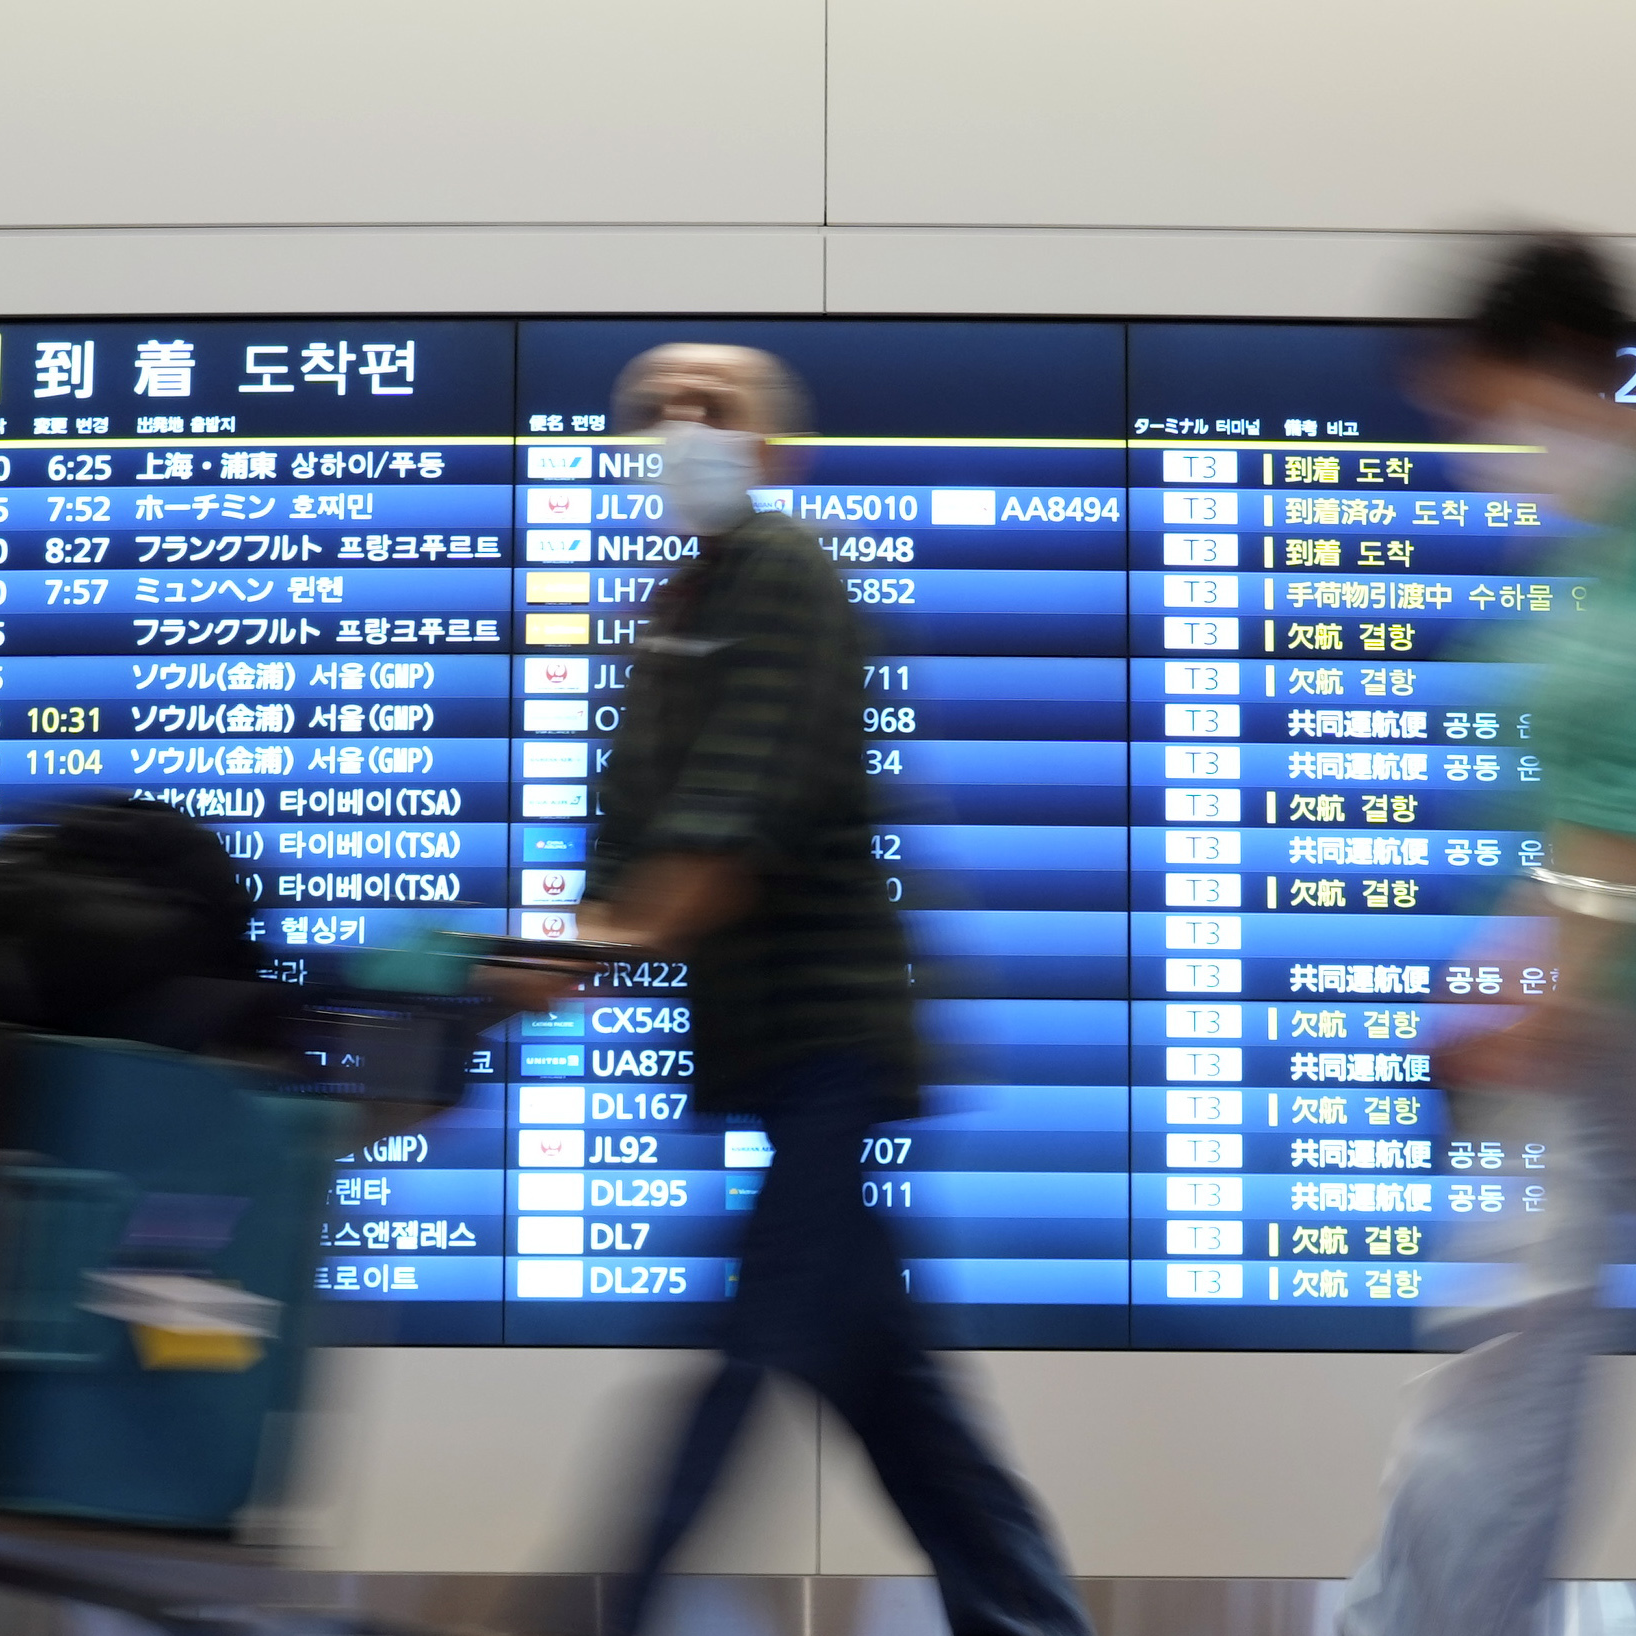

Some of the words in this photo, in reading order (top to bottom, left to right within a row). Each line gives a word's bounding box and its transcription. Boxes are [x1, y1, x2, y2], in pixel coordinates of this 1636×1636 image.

[239, 341, 414, 395] 도착편
[571, 415, 605, 431] 편명
[1135, 418, 1208, 434] ターミナル
[1216, 419, 1259, 435] 터미널
[1327, 421, 1359, 436] 비고
[48, 455, 111, 480] 6:25
[291, 452, 445, 478] 상하이/푸동
[600, 453, 663, 477] NH9
[1183, 456, 1216, 478] T3
[1285, 457, 1340, 483] 到着
[1357, 458, 1413, 484] 도착
[48, 496, 110, 522] 7:52
[136, 494, 275, 520] ホーチミン
[290, 493, 372, 519] 호찌민
[596, 495, 663, 519] JL70
[801, 495, 917, 520] HA5010
[1001, 497, 1119, 522] AA8494
[1183, 498, 1216, 520] T3
[1286, 498, 1396, 525] 到着済み
[1413, 500, 1468, 526] 도착
[1485, 501, 1540, 527] 완료
[46, 538, 110, 563] 8:27
[136, 535, 322, 562] フランクフルト
[338, 535, 501, 561] 프랑크푸르트
[598, 536, 699, 561] NH204
[819, 537, 913, 562] H4948
[1183, 539, 1216, 561] T3
[1286, 539, 1341, 566] 到着
[1358, 540, 1414, 567] 도착
[45, 579, 108, 605] 7:57
[136, 578, 273, 603] ミュンヘン
[288, 576, 343, 603] 뮌헨
[598, 578, 667, 602] LH7
[848, 579, 915, 603] 5852
[1184, 581, 1217, 603] T3
[1287, 581, 1452, 609] 手荷物引渡中
[1469, 584, 1553, 611] 수하물
[134, 618, 320, 645] フランクフルト
[336, 618, 500, 644] 프랑크푸르트
[1183, 623, 1217, 645] T3
[1288, 623, 1342, 650] 欠航
[1360, 623, 1415, 651] 결항
[133, 662, 295, 691] ソウル(金浦)
[864, 666, 908, 690] 711
[1184, 668, 1218, 690] T3
[1289, 668, 1343, 695] 欠航
[1361, 668, 1416, 696] 결항
[28, 707, 98, 732] 10:31
[132, 704, 294, 733] ソウル(金浦)
[864, 708, 915, 733] 968
[1185, 710, 1218, 732] T3
[1288, 710, 1427, 738] 共同運航便
[1443, 713, 1499, 739] 공동
[27, 749, 102, 774] 11:04
[131, 746, 294, 775] ソウル(金浦)
[867, 750, 902, 774] 34
[1185, 752, 1218, 774] T3
[1289, 752, 1428, 780] 共同運航便
[1444, 755, 1500, 781] 공동
[1517, 756, 1540, 781] 운
[280, 788, 461, 816] 타이베이(TSA)
[1185, 794, 1219, 817] T3
[1290, 794, 1345, 821] 欠航
[1362, 795, 1417, 822] 결항
[280, 831, 460, 858] 타이베이(TSA)
[1186, 837, 1219, 859] T3
[1289, 836, 1428, 865] 共同運航便
[1445, 840, 1501, 866] 공동
[1518, 841, 1544, 866] 운
[279, 873, 459, 901] 타이베이(TSA)
[1186, 879, 1219, 902] T3
[1291, 879, 1345, 906] 欠航
[1363, 879, 1418, 907] 결항
[282, 916, 364, 944] 헬싱키
[1186, 922, 1220, 945] T3
[1186, 965, 1219, 987] T3
[1290, 964, 1430, 993] 共同運航便
[1446, 967, 1503, 994] 공동
[1520, 968, 1546, 993] 운
[592, 1007, 688, 1033] CX548
[1187, 1011, 1220, 1033] T3
[1292, 1010, 1346, 1038] 欠航
[1364, 1010, 1420, 1038] 결항
[593, 1050, 693, 1076] UA875
[1187, 1054, 1220, 1076] T3
[1291, 1053, 1430, 1081] 共同運航便
[592, 1093, 687, 1119] DL167
[1188, 1097, 1220, 1119] T3
[1292, 1096, 1347, 1124] 欠航
[1365, 1096, 1420, 1124] 결항
[589, 1136, 657, 1163] JL92
[861, 1139, 911, 1163] 707
[1188, 1140, 1220, 1163] T3
[1291, 1139, 1431, 1168] 共同運航便
[1448, 1143, 1504, 1169] 공동
[1522, 1144, 1545, 1168] 운
[337, 1177, 391, 1205] 랜타
[592, 1180, 687, 1206] DL295
[865, 1182, 910, 1207] 011
[1188, 1183, 1220, 1206] T3
[1291, 1182, 1431, 1211] 共同運航便
[1448, 1185, 1505, 1212] 공동
[1522, 1186, 1544, 1211] 운
[591, 1223, 649, 1249] DL7
[1188, 1227, 1220, 1249] T3
[1293, 1226, 1348, 1254] 欠航
[1366, 1226, 1421, 1255] 결항
[315, 1263, 418, 1292] 트로이트
[591, 1267, 686, 1293] DL275
[1188, 1270, 1221, 1293] T3
[1293, 1270, 1348, 1297] 欠航
[1366, 1269, 1422, 1298] 결항
